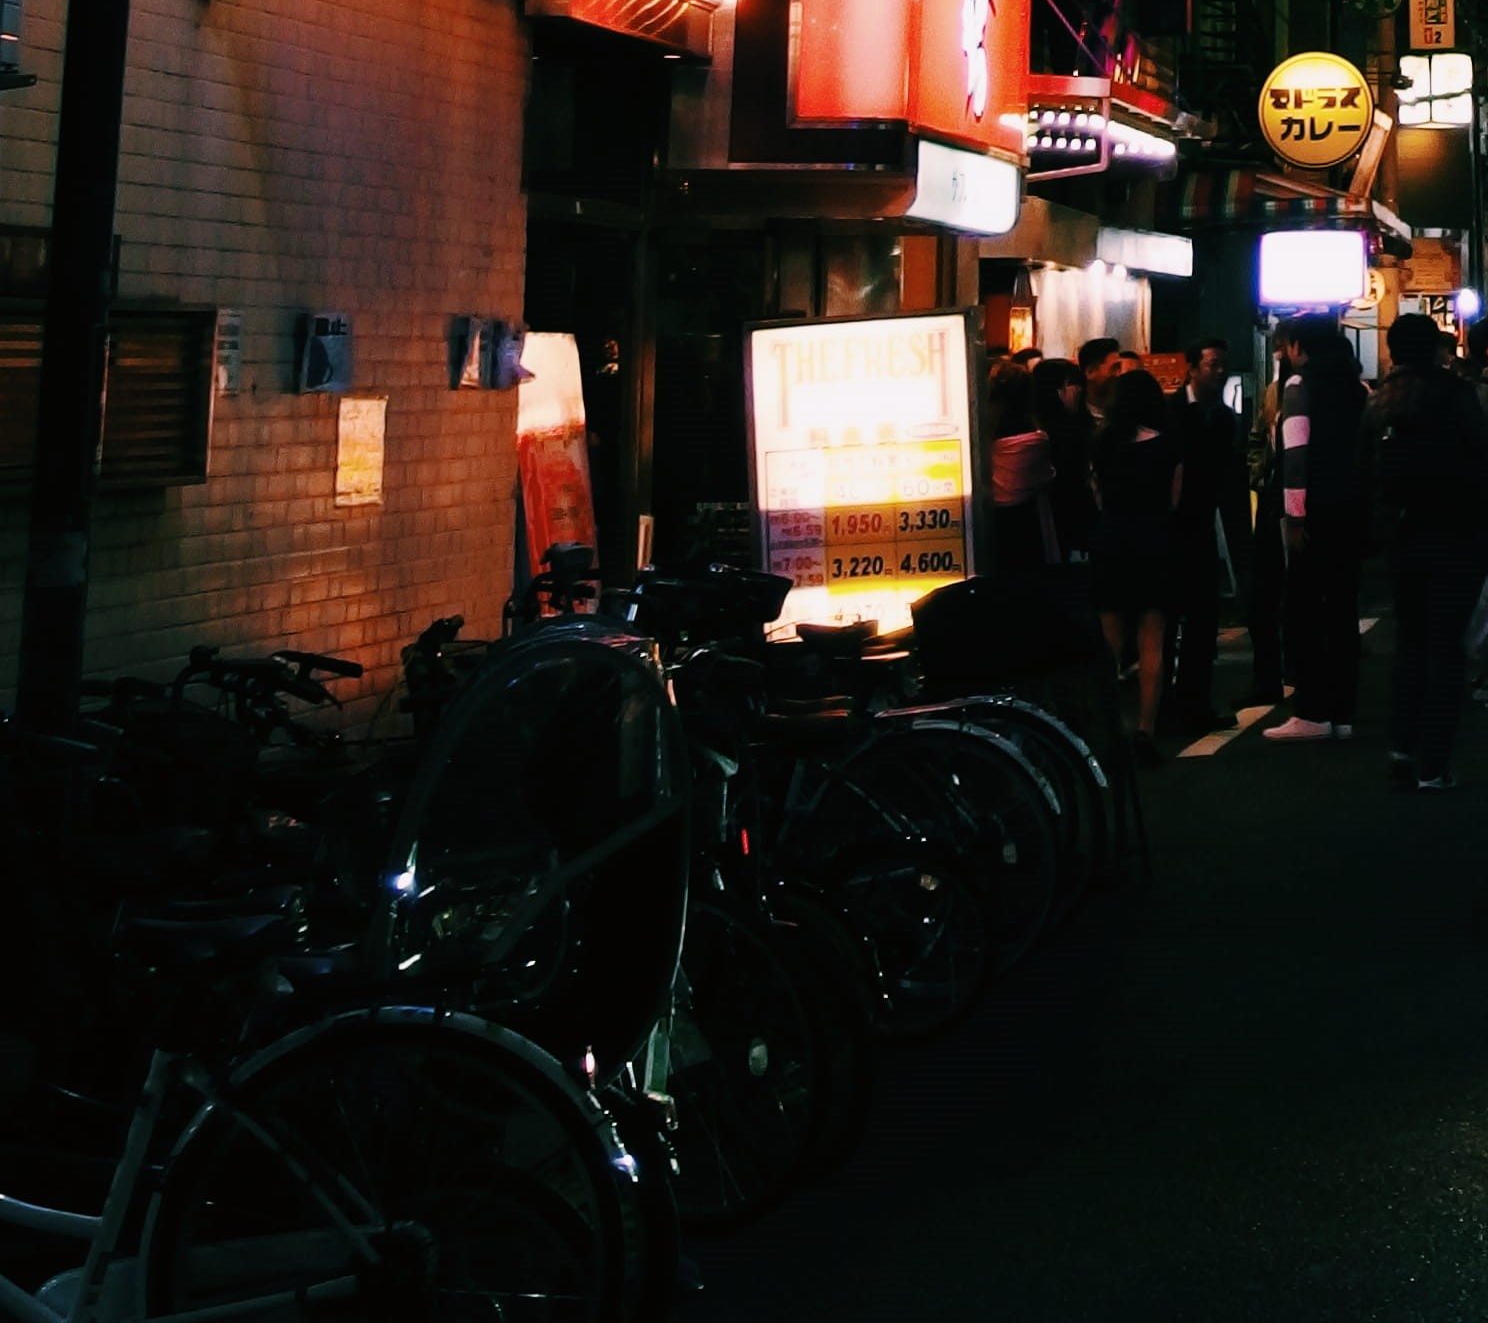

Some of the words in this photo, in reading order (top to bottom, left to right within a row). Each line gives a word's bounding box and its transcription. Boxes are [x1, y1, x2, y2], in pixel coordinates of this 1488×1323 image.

[1269, 87, 1363, 109] マドラス
[1280, 117, 1361, 142] カレー
